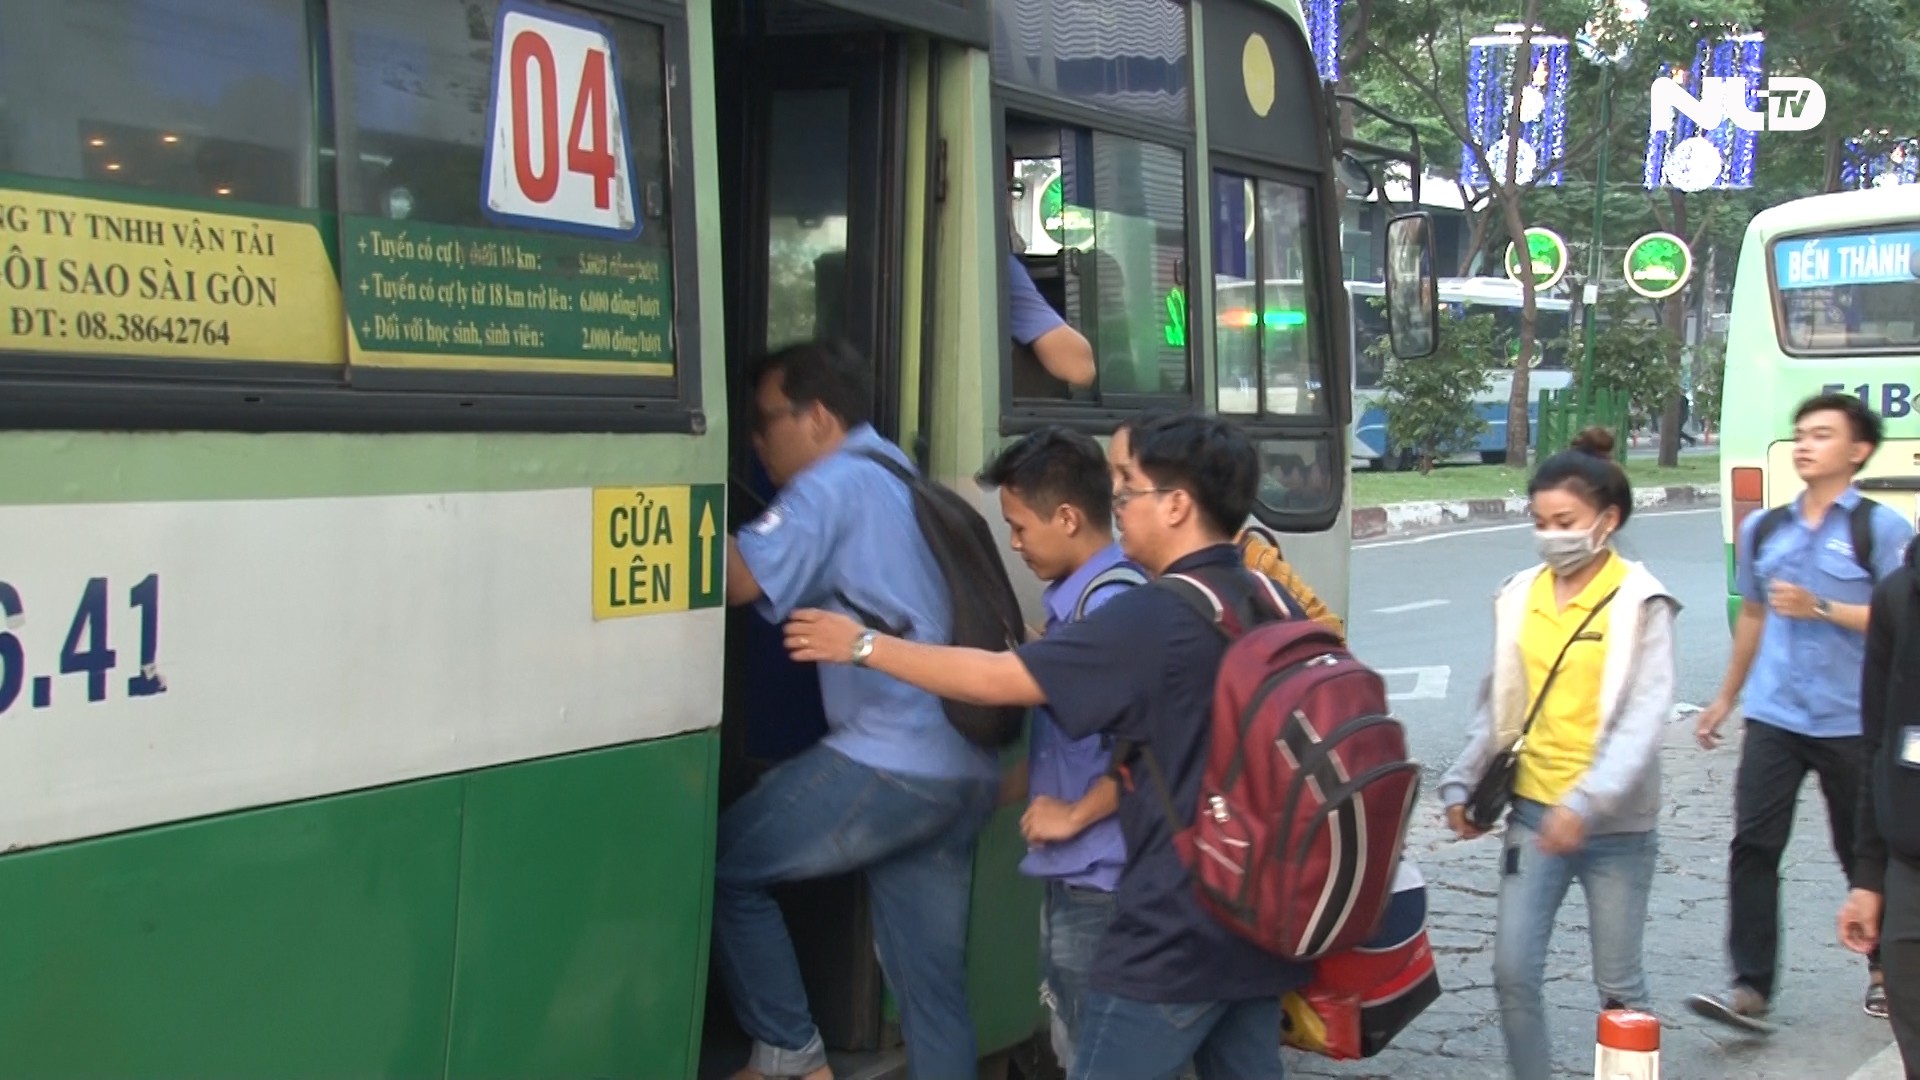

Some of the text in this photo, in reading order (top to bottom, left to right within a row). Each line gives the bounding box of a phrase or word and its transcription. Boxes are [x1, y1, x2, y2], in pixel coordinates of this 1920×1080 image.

[511, 30, 616, 209] 04
[0, 204, 275, 255] G TY TNHH VẬN TẢI
[369, 230, 414, 263] Tuyến
[417, 236, 433, 260] có
[516, 246, 542, 271] km:
[0, 244, 276, 307] ÔI SAO SÀI GÒN
[1788, 238, 1911, 282] BẾN THÀNH
[371, 272, 416, 305] Tuyến
[419, 278, 435, 301] có
[457, 280, 468, 310] ly
[471, 281, 486, 305] từ
[490, 283, 503, 306] 18
[505, 284, 525, 308] km
[549, 287, 573, 311] lên:
[580, 289, 609, 313] 6.000
[10, 306, 230, 346] ĐT: 08.38642764
[403, 317, 424, 342] với
[426, 318, 450, 347] học
[452, 319, 483, 347] sinh,
[485, 321, 510, 346] sinh
[513, 323, 544, 348] viên:
[582, 327, 611, 350] 2.000
[610, 491, 673, 548] CỬA
[609, 554, 671, 607] LÊN
